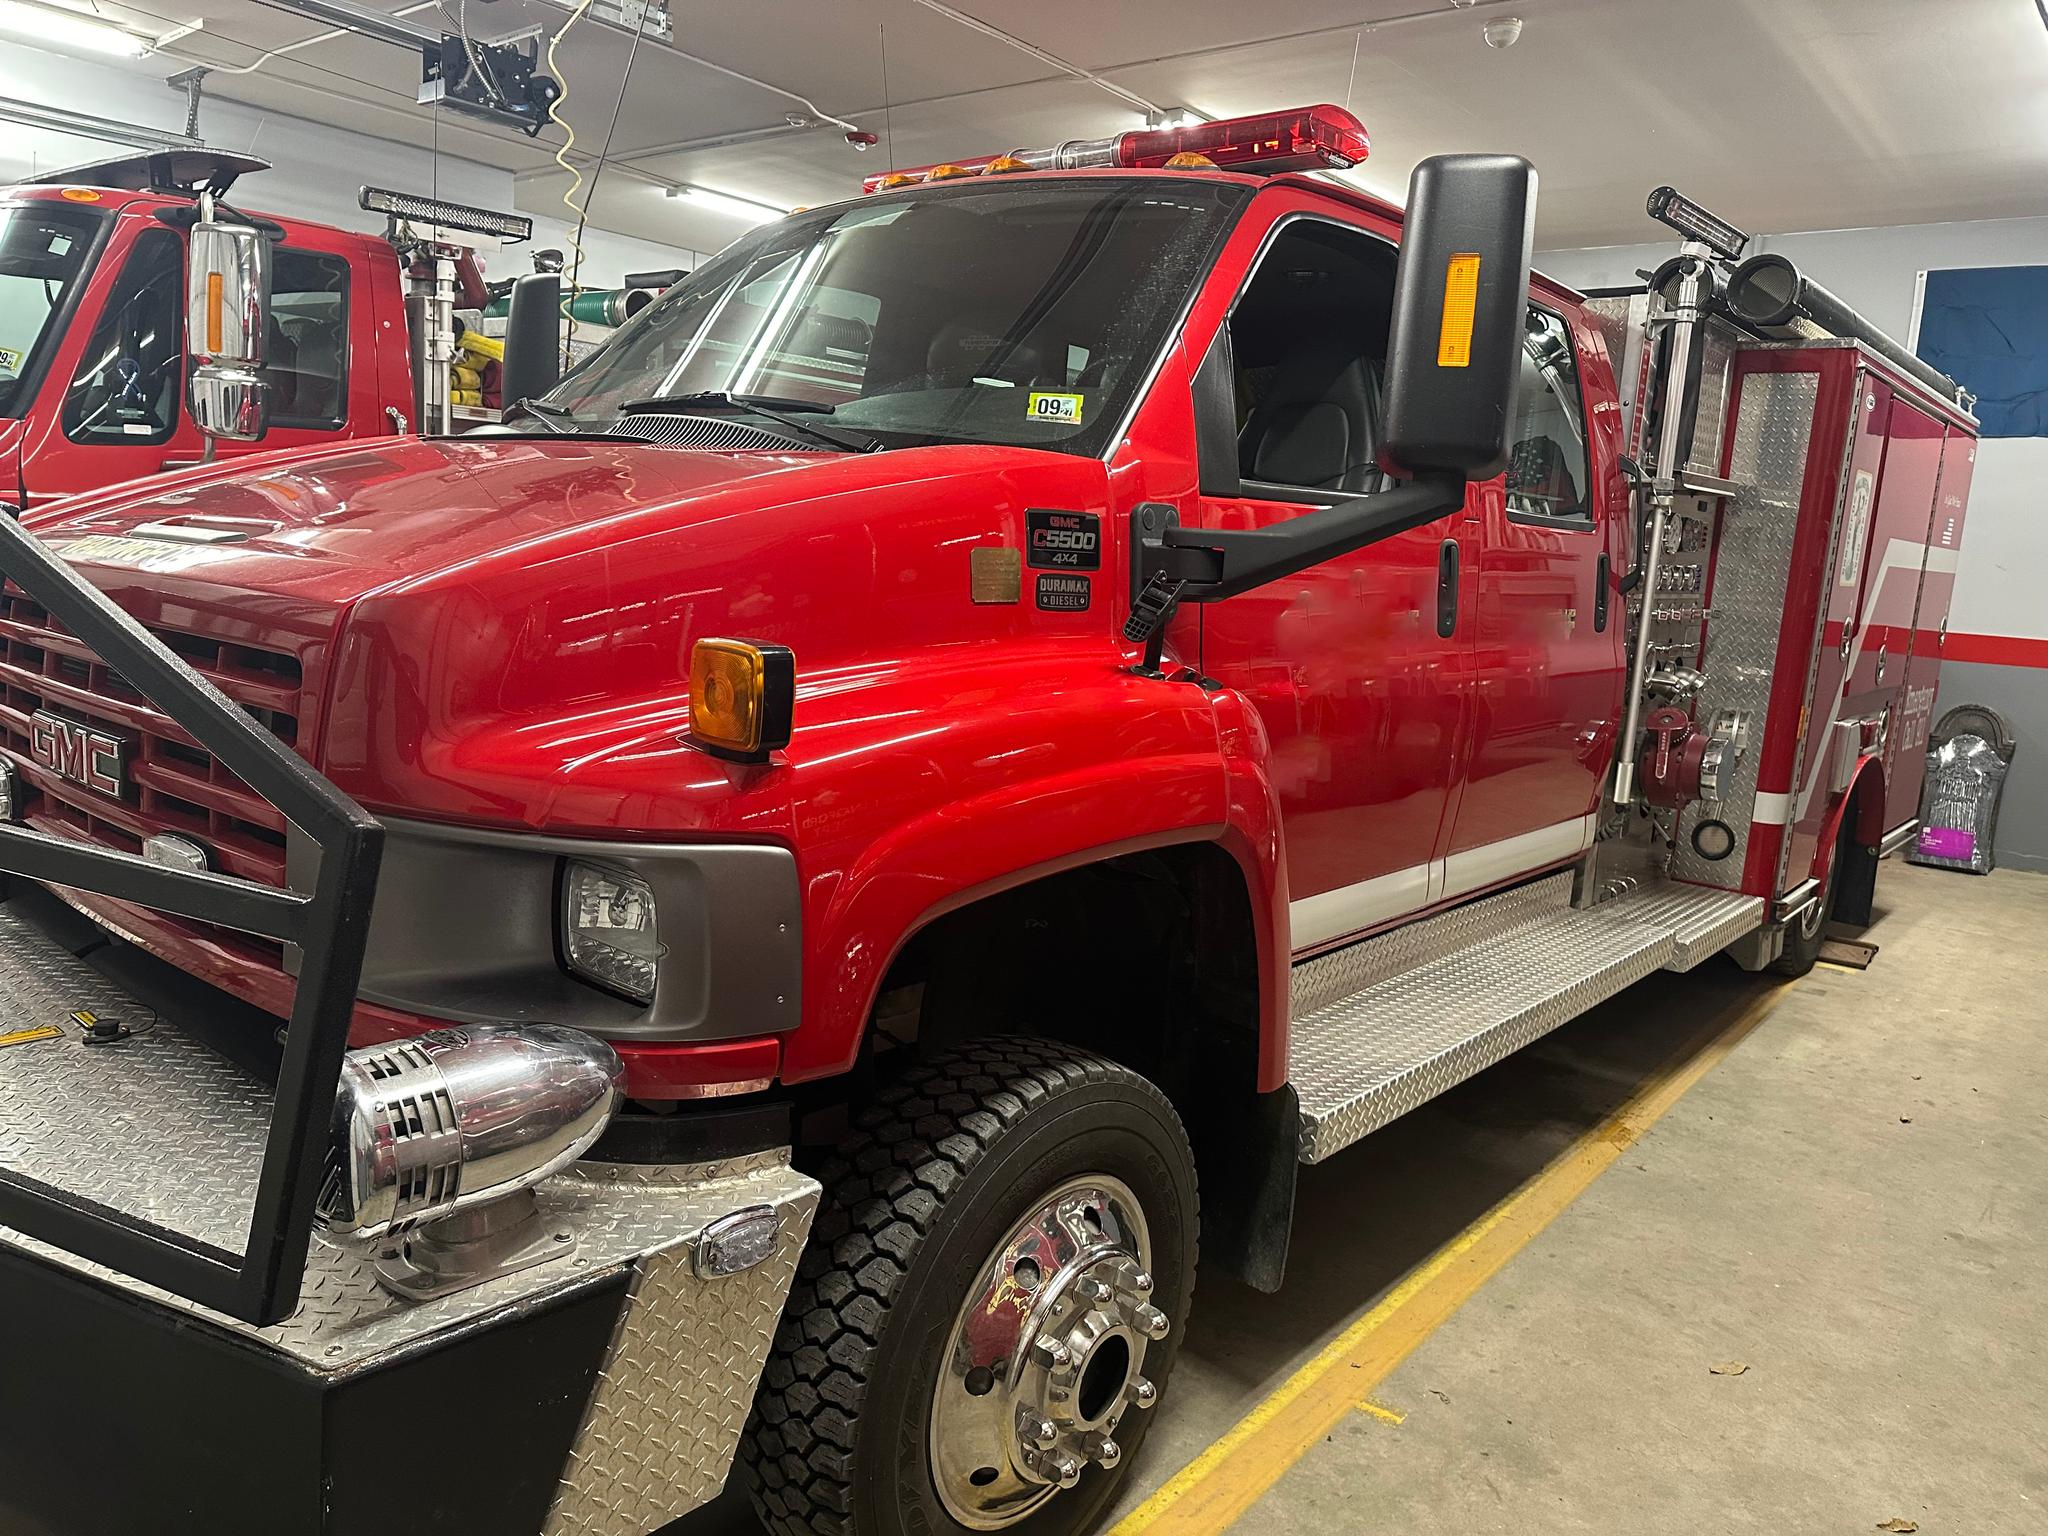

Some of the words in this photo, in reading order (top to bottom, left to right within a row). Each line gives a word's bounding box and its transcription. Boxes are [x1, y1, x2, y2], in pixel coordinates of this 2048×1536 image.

[1037, 398, 1061, 415] 09
[1049, 516, 1080, 529] GMC
[1033, 529, 1096, 550] C5500
[1040, 578, 1088, 593] DURAMAX
[1050, 595, 1078, 606] DIESEL
[29, 712, 119, 797] GMC
